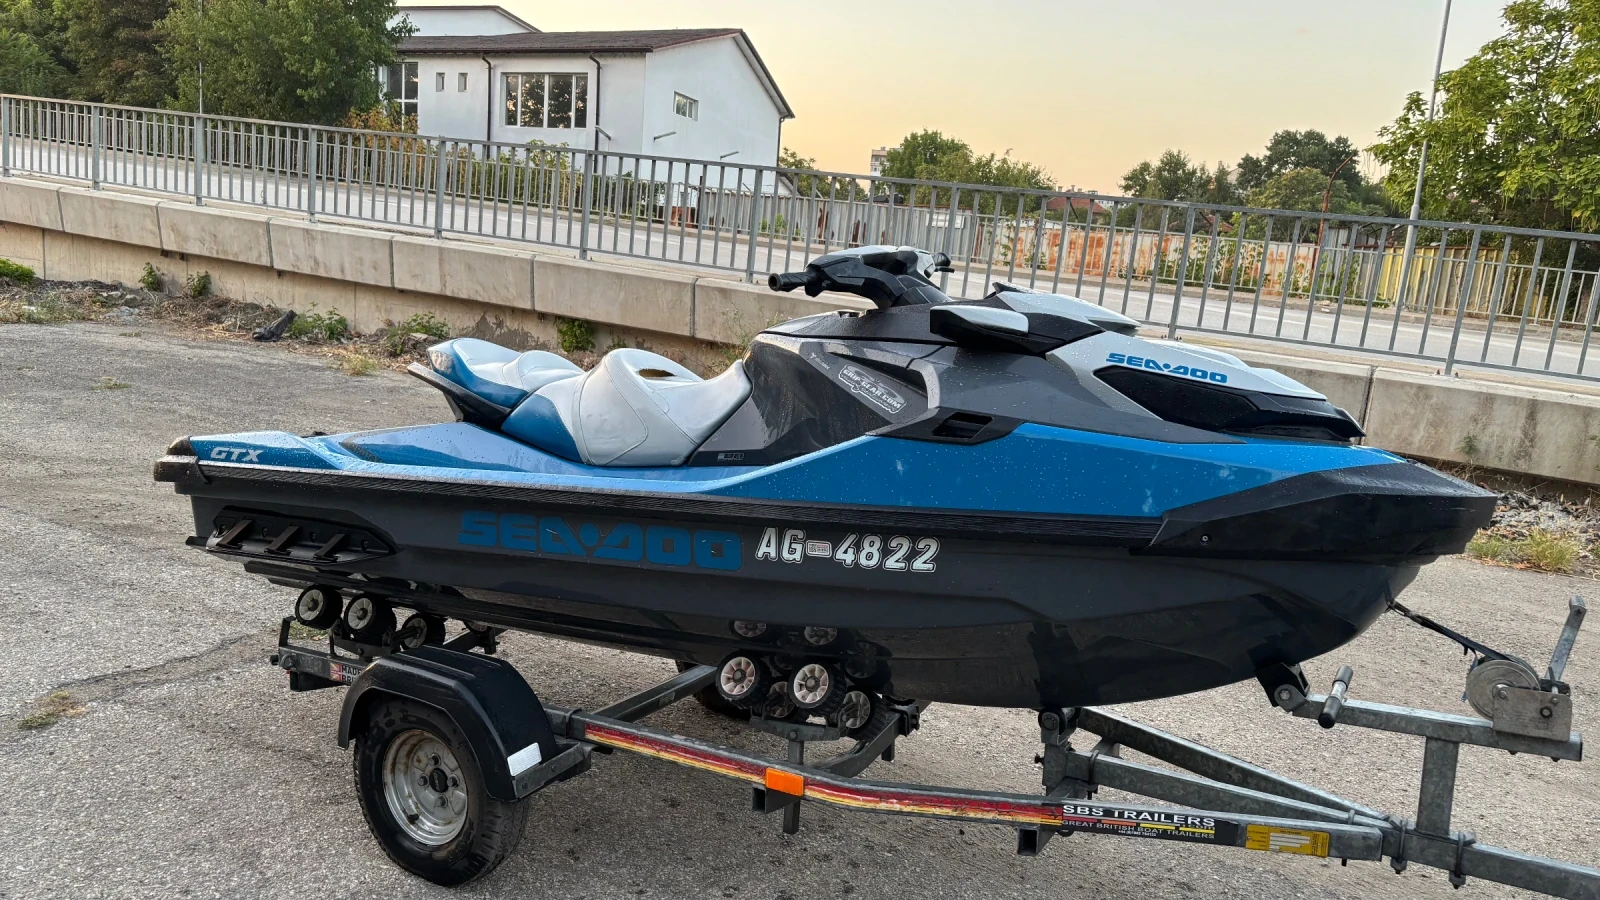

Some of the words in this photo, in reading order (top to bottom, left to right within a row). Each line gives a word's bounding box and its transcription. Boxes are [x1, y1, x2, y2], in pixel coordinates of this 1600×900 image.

[210, 446, 263, 462] GTX
[755, 526, 940, 572] AG-4822
[1063, 804, 1104, 816] SBS
[1112, 809, 1215, 826] TRAILERS
[1062, 820, 1094, 828] GREAT
[1097, 822, 1135, 832] BRITISH
[1166, 828, 1215, 839] TRAILERS
